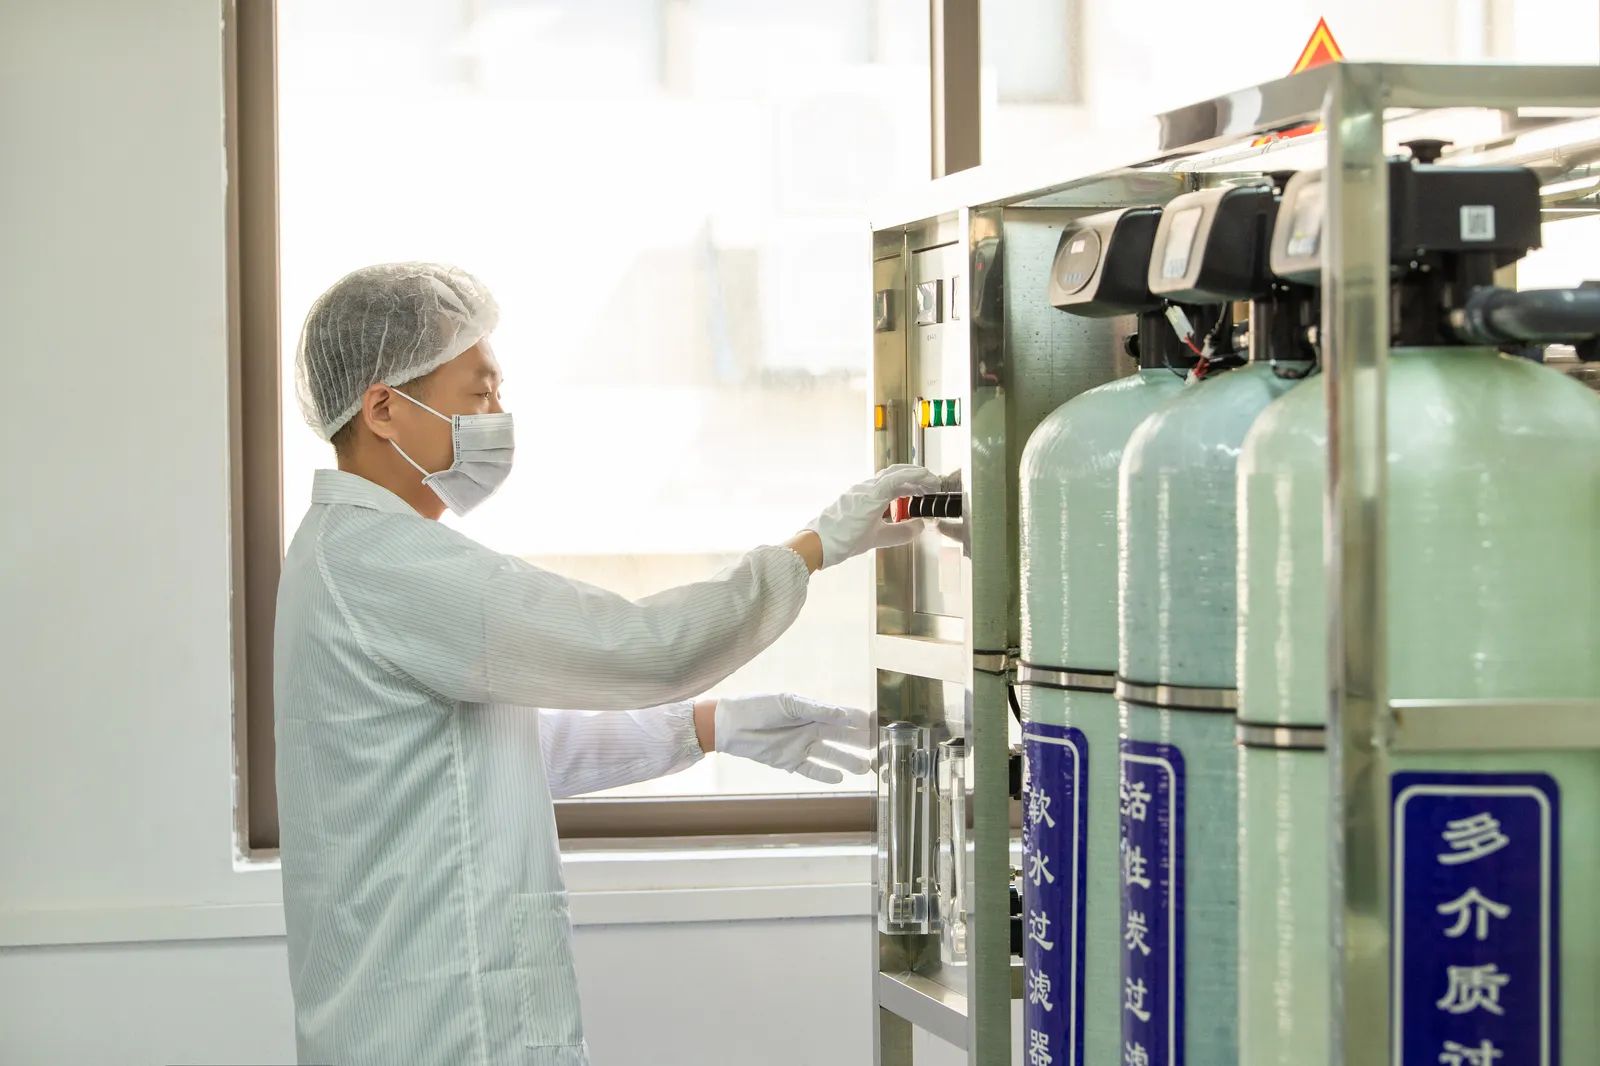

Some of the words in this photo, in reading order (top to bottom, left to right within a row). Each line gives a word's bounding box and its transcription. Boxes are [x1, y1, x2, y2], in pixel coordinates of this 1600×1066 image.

[1027, 784, 1056, 1066] 软水过滤器
